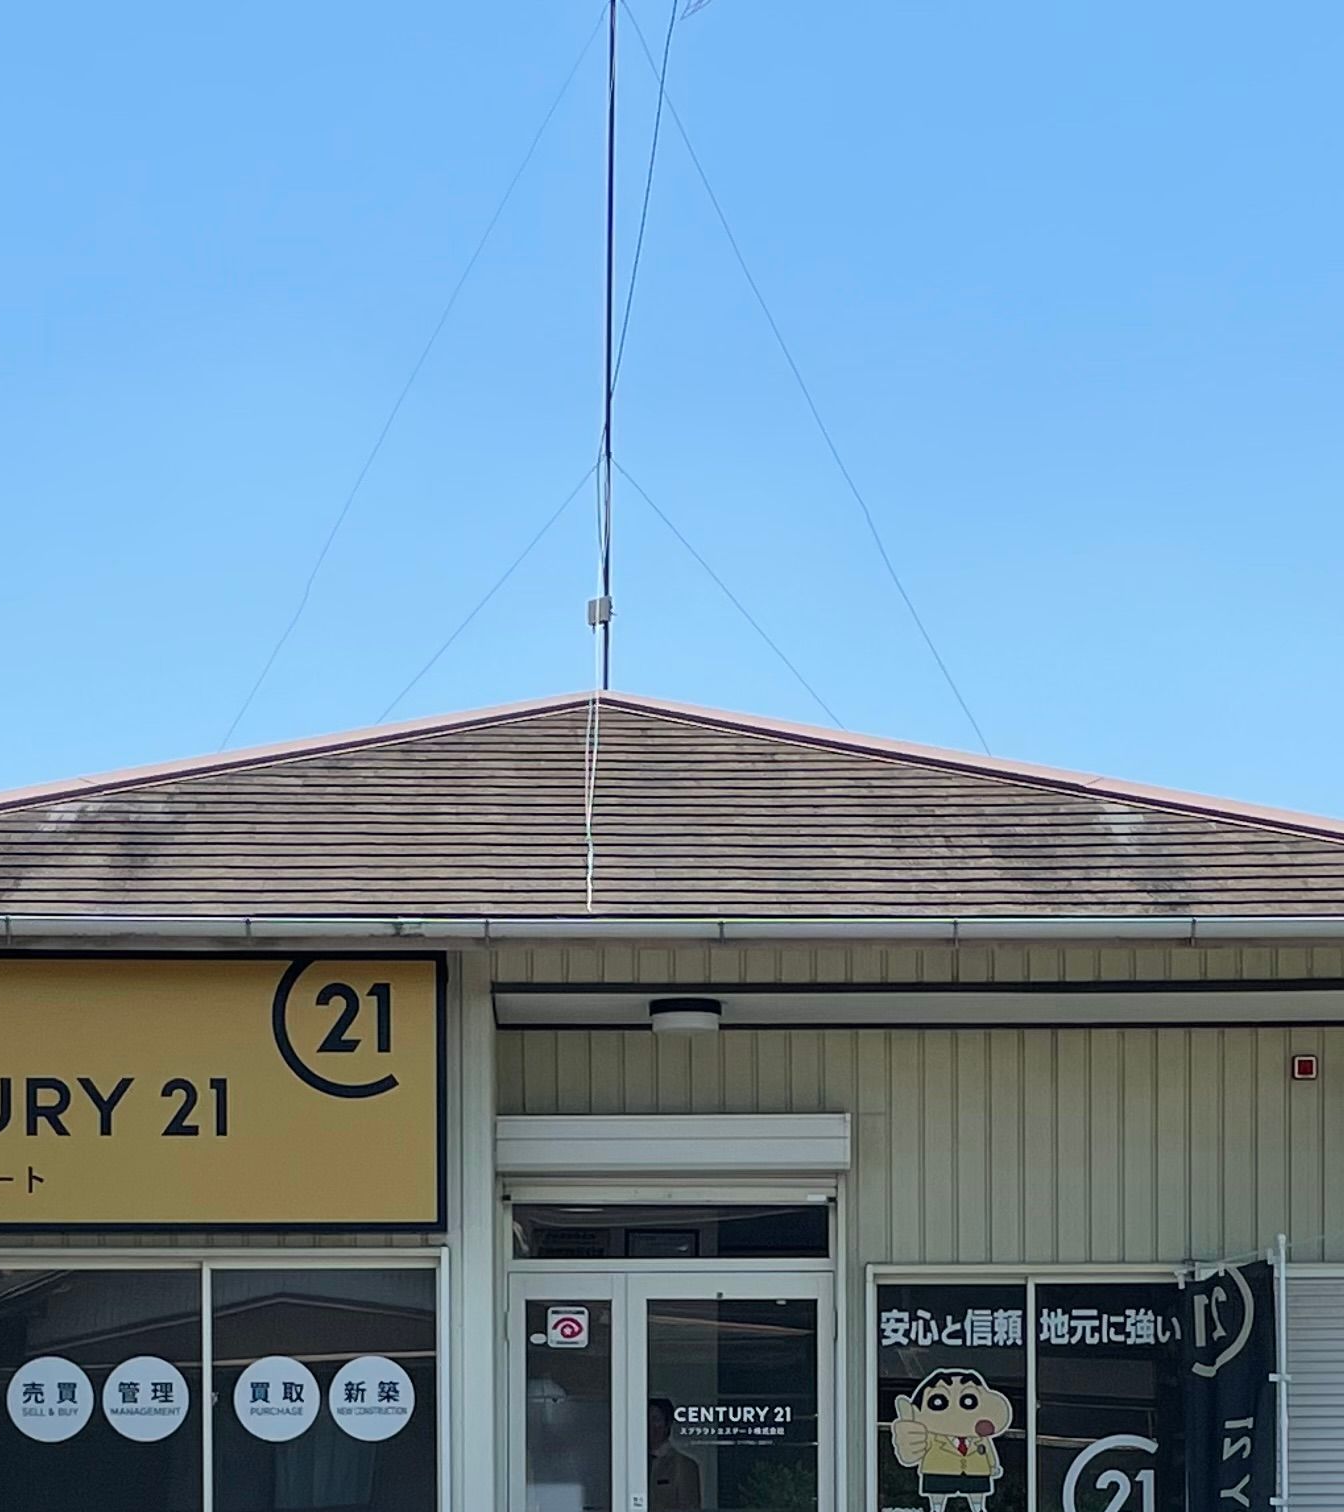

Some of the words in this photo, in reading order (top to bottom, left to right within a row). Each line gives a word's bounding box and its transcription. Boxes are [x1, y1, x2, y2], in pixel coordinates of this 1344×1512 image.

[160, 1077, 228, 1137] 21
[880, 1309, 1023, 1347] 安心と信頼
[1039, 1308, 1182, 1347] 地元に強い
[22, 1381, 78, 1404] 売買
[118, 1381, 174, 1404] 管理
[250, 1381, 305, 1404] 買取
[344, 1380, 400, 1404] 新築
[58, 1407, 79, 1417] BUY
[110, 1407, 181, 1417] MANAGEMENT
[250, 1406, 304, 1416] PURCHASE
[673, 1406, 770, 1423] CENTURY
[773, 1406, 792, 1423] 21
